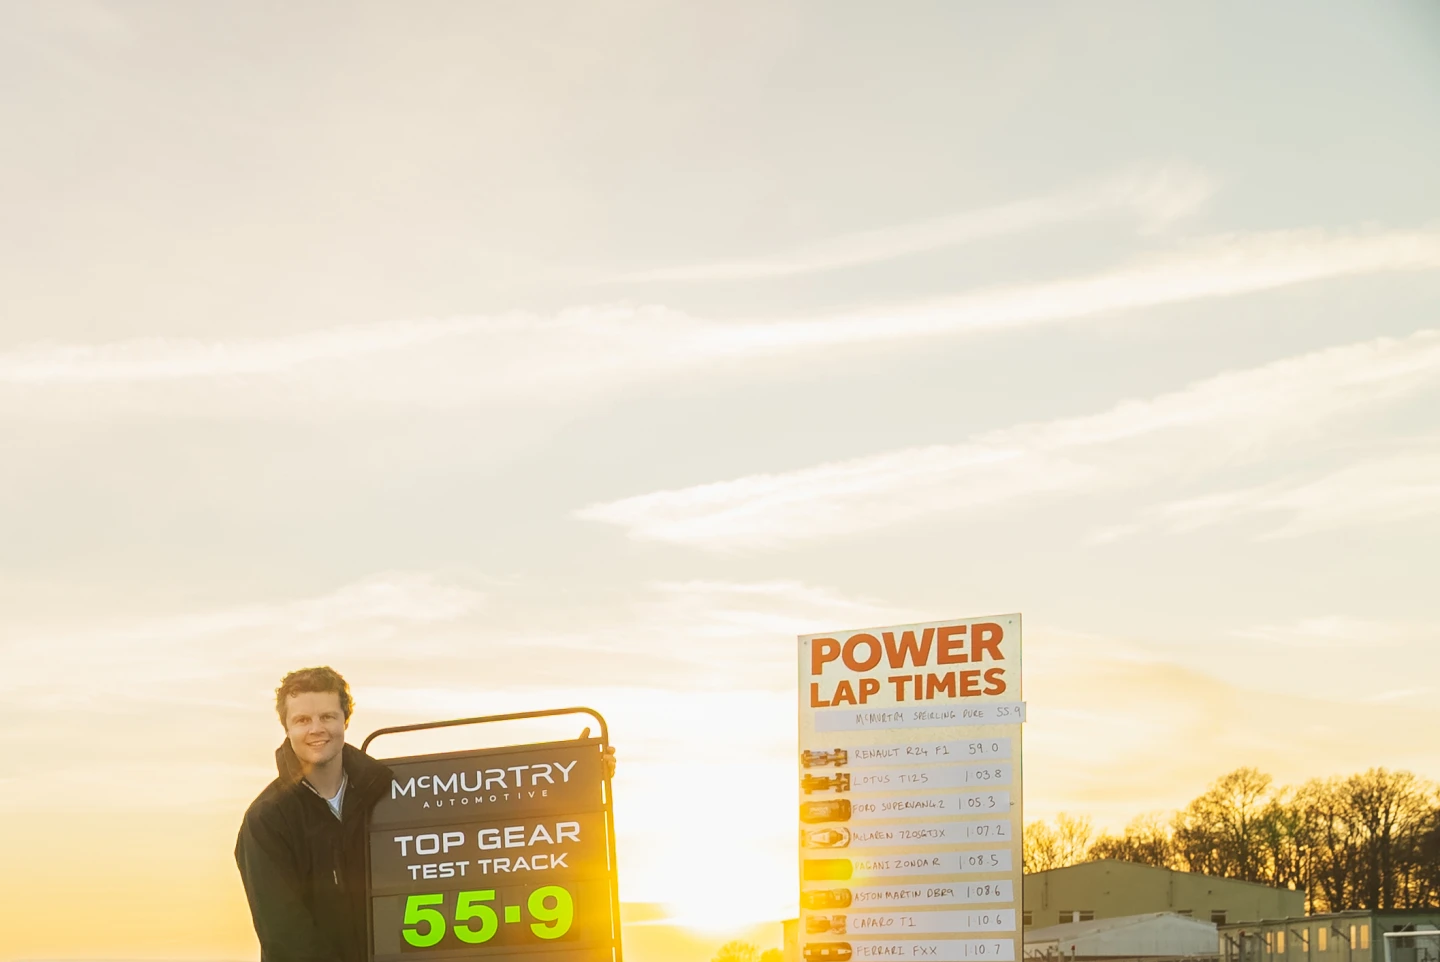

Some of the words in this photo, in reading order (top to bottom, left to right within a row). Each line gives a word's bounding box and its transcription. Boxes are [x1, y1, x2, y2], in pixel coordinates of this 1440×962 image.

[811, 622, 1005, 675] POWER
[810, 677, 881, 708] LAP
[887, 667, 1007, 702] TIMES
[913, 709, 956, 721] SPEIRLING
[996, 706, 1022, 718] 55.9
[855, 748, 900, 759] RENAULT
[906, 747, 928, 756] R24
[935, 746, 950, 756] F1
[968, 742, 999, 755] 59.0
[853, 772, 890, 786] LOTUS
[898, 774, 929, 784] T125
[423, 790, 548, 808] AUTOMOTIVE
[852, 801, 876, 814] FORD
[394, 831, 465, 856] TOP
[477, 821, 581, 850] GEAR
[408, 860, 470, 880] TEST
[478, 852, 568, 875] TRACK
[855, 860, 890, 871] PAGANI
[895, 858, 929, 870] ZONDA
[932, 858, 941, 867] R
[854, 892, 883, 902] ASTON
[884, 889, 921, 900] MARTIN
[927, 888, 954, 898] DBR9
[853, 918, 894, 928] CAPARO
[900, 917, 916, 928] T1
[857, 946, 905, 956] FERRARI
[913, 946, 937, 955] FXX
